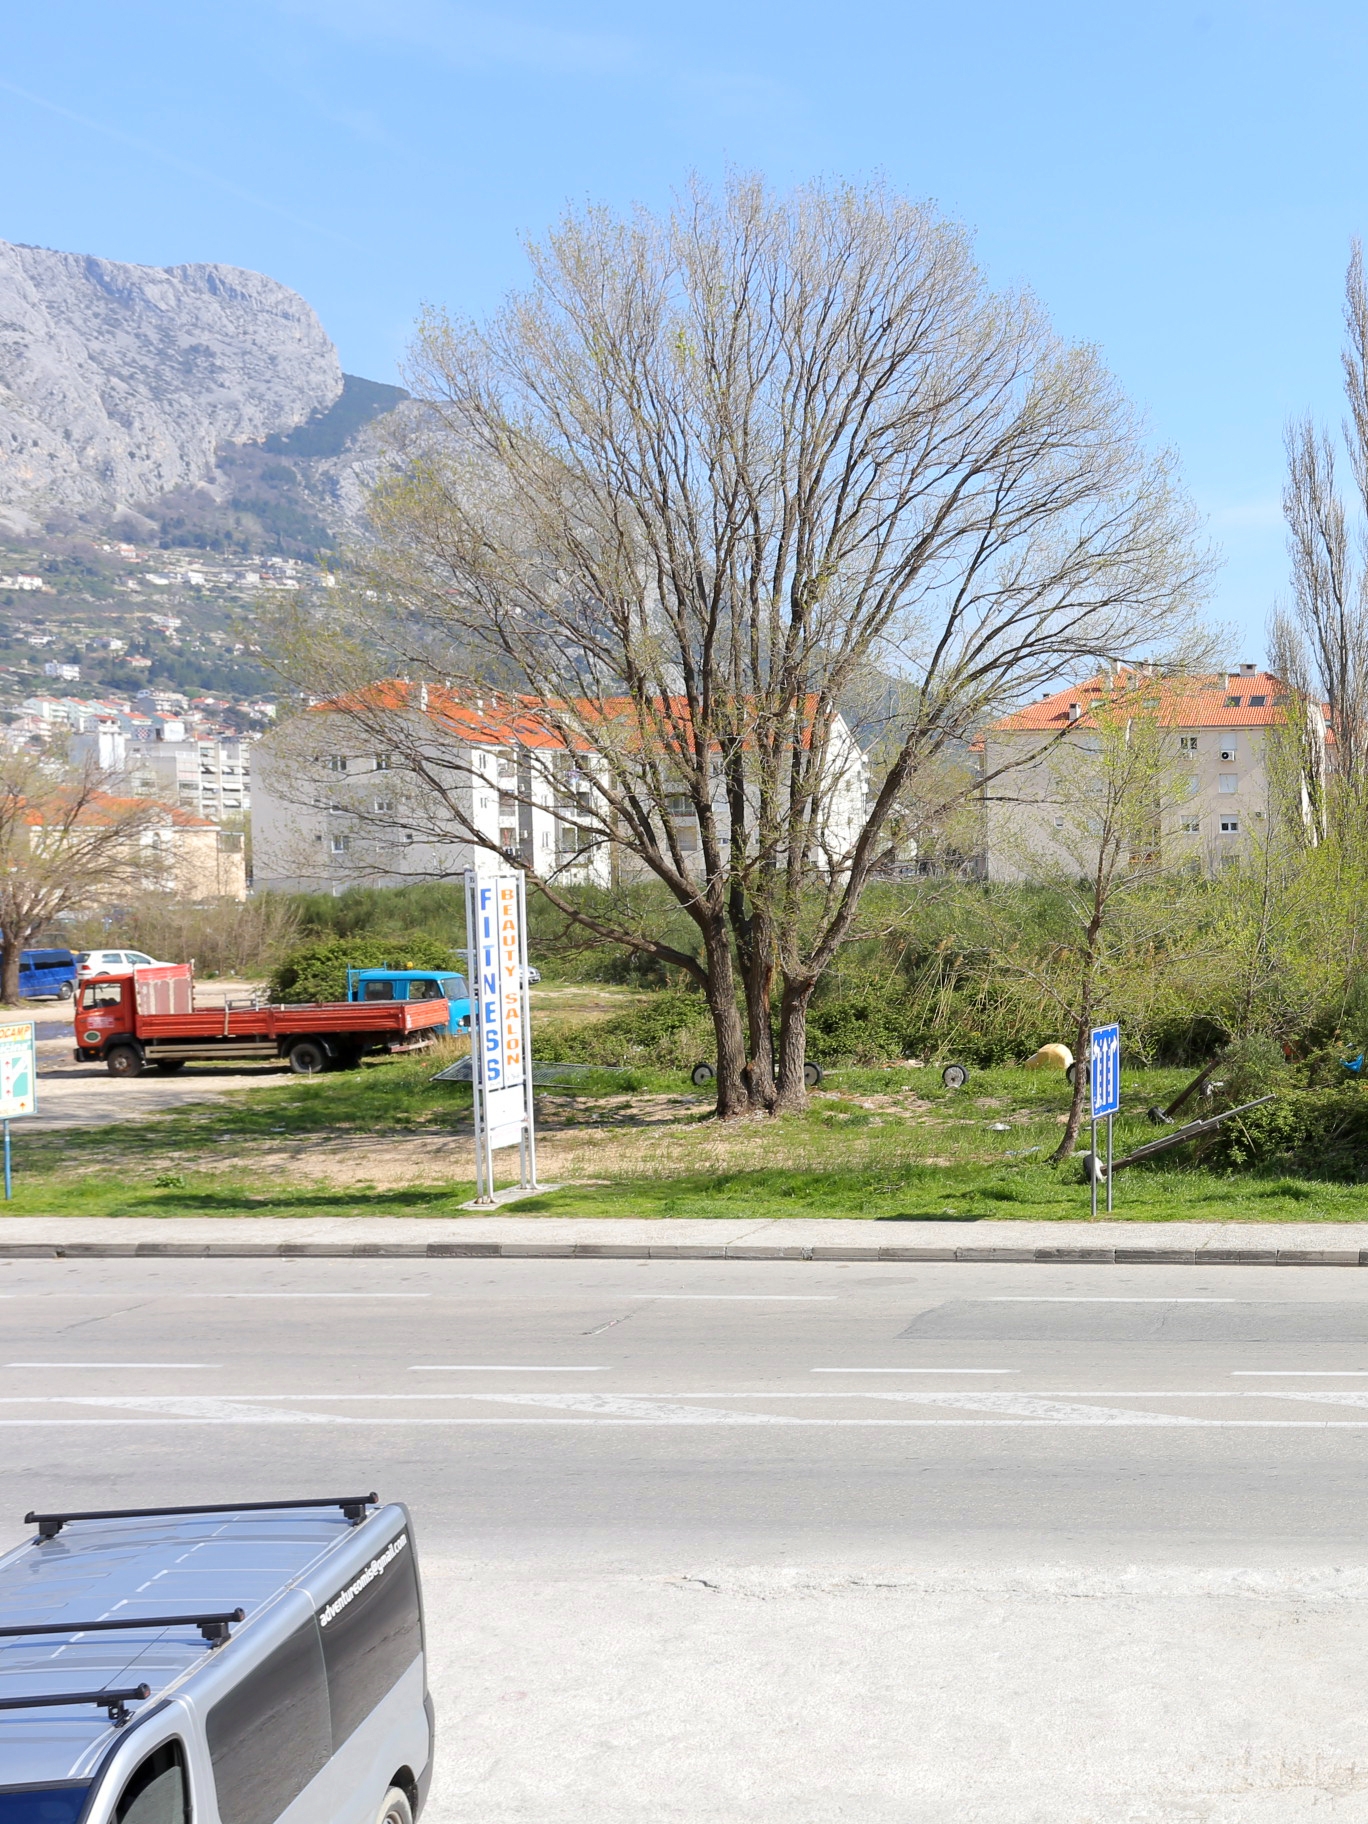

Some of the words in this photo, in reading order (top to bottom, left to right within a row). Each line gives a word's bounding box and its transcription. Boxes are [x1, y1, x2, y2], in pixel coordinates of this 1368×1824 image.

[501, 889, 518, 978] BEAUTY
[480, 888, 501, 1081] FITNESS
[504, 992, 521, 1067] SALON
[319, 1533, 407, 1627] adventureomis@gmail.com
